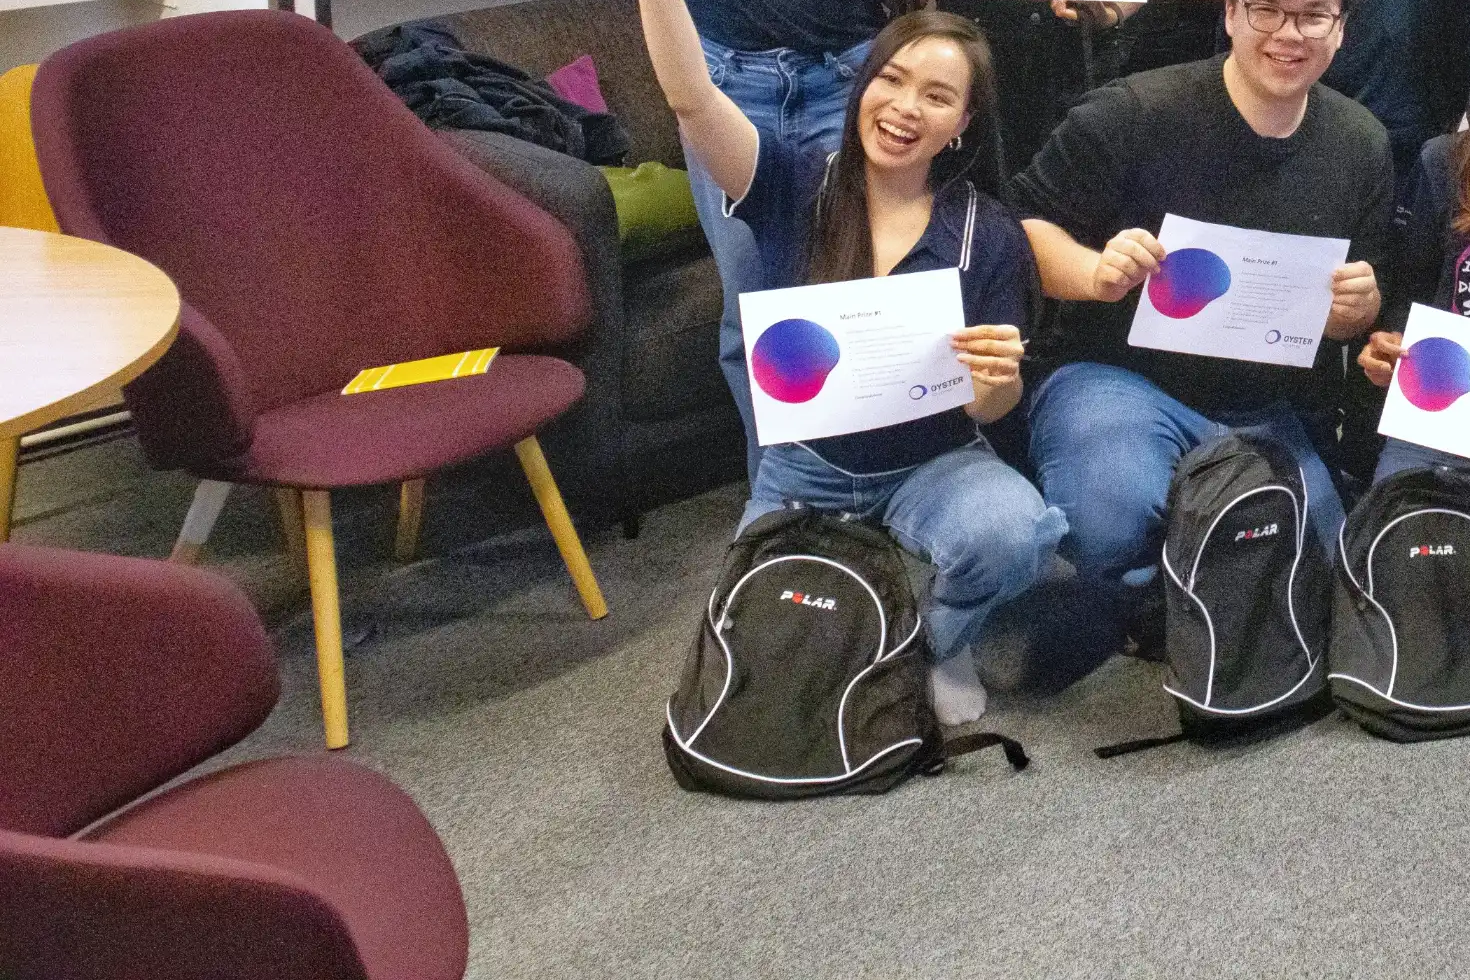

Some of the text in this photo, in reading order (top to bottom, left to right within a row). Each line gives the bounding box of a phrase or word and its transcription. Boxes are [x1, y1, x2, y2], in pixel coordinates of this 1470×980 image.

[1283, 335, 1314, 346] OYSTER
[930, 375, 965, 393] OYSTER
[1234, 523, 1278, 541] POLAR
